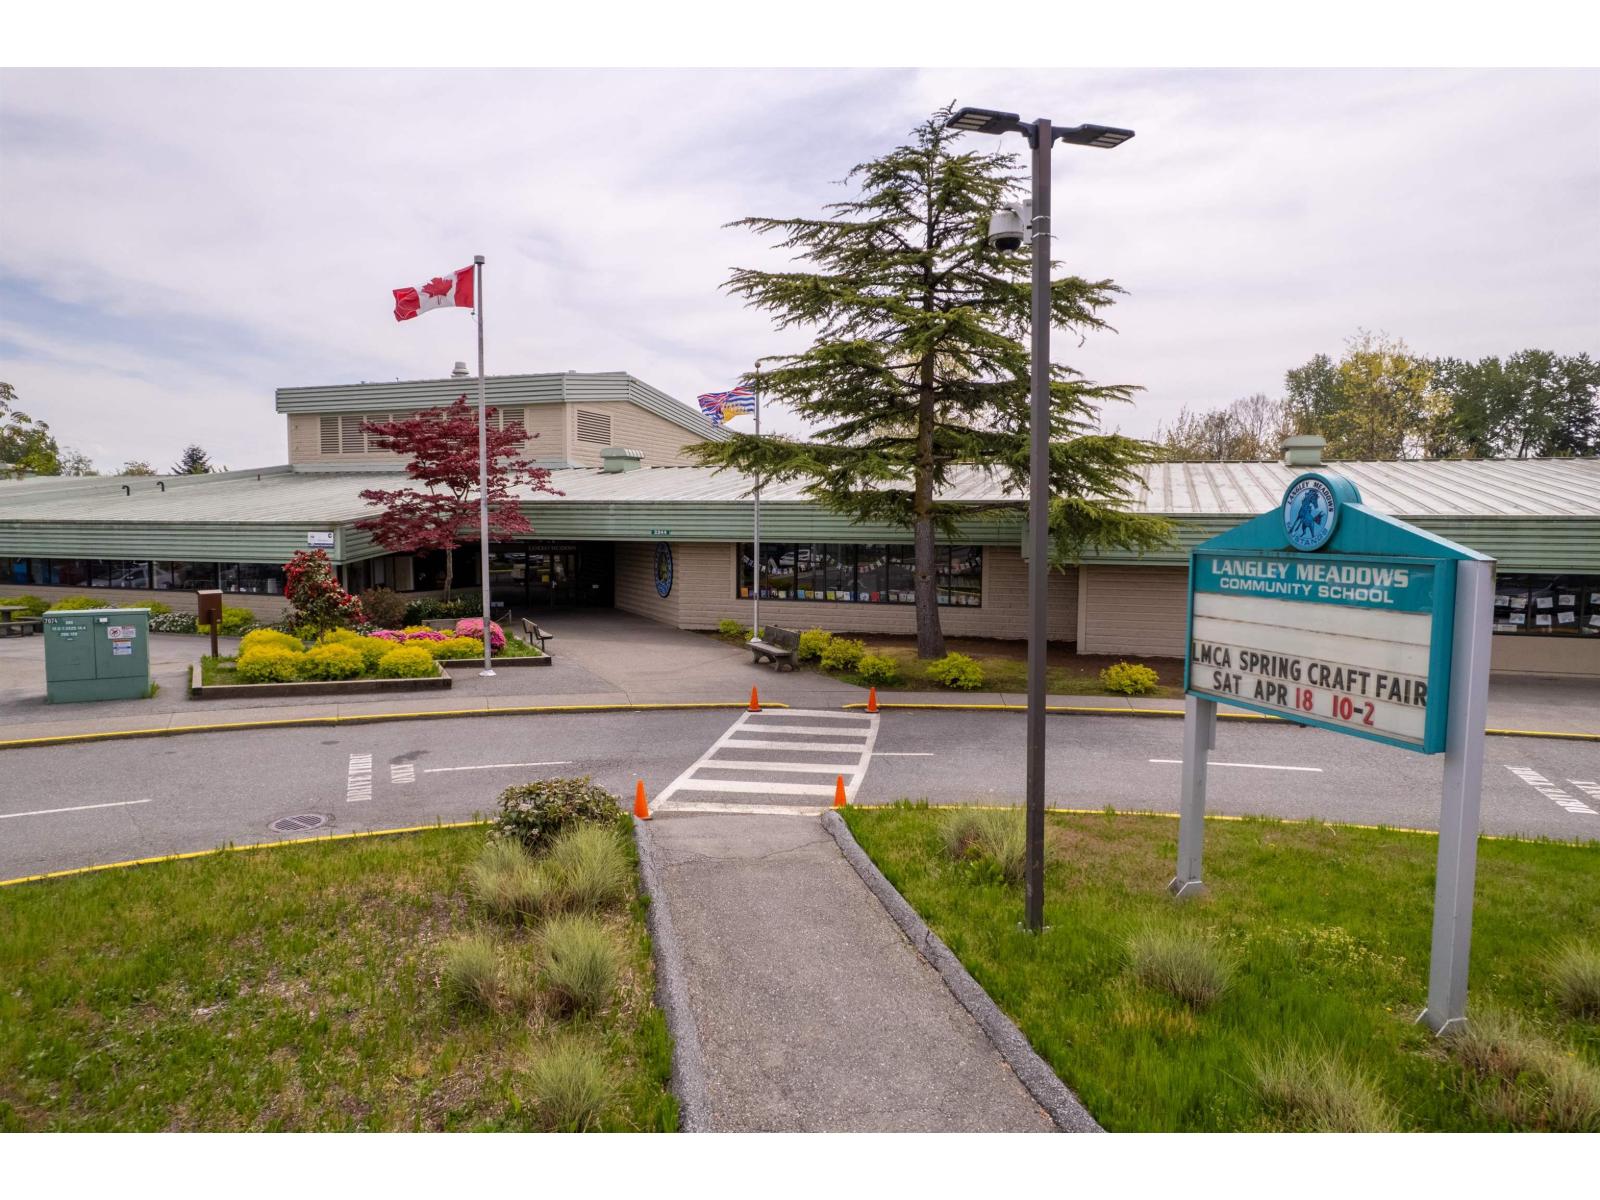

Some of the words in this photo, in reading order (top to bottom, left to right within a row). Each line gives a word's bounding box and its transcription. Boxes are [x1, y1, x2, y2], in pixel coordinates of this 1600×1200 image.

[1287, 481, 1310, 505] LANGLEY
[1313, 481, 1335, 513] MEADOWS
[1211, 559, 1290, 579] LANGLEY
[1296, 563, 1409, 588] MEADOWS
[1220, 577, 1313, 596] COMMUNITY
[1318, 585, 1394, 603] SCHOOL
[1192, 642, 1231, 669] LMCA
[1239, 650, 1301, 681] SPRING
[1307, 662, 1371, 695] CRAFT
[1375, 674, 1428, 707] FAIR
[1213, 670, 1242, 695] SAT
[1254, 679, 1288, 706] APR
[1295, 687, 1313, 712] 18
[1332, 695, 1375, 726] 10-2
